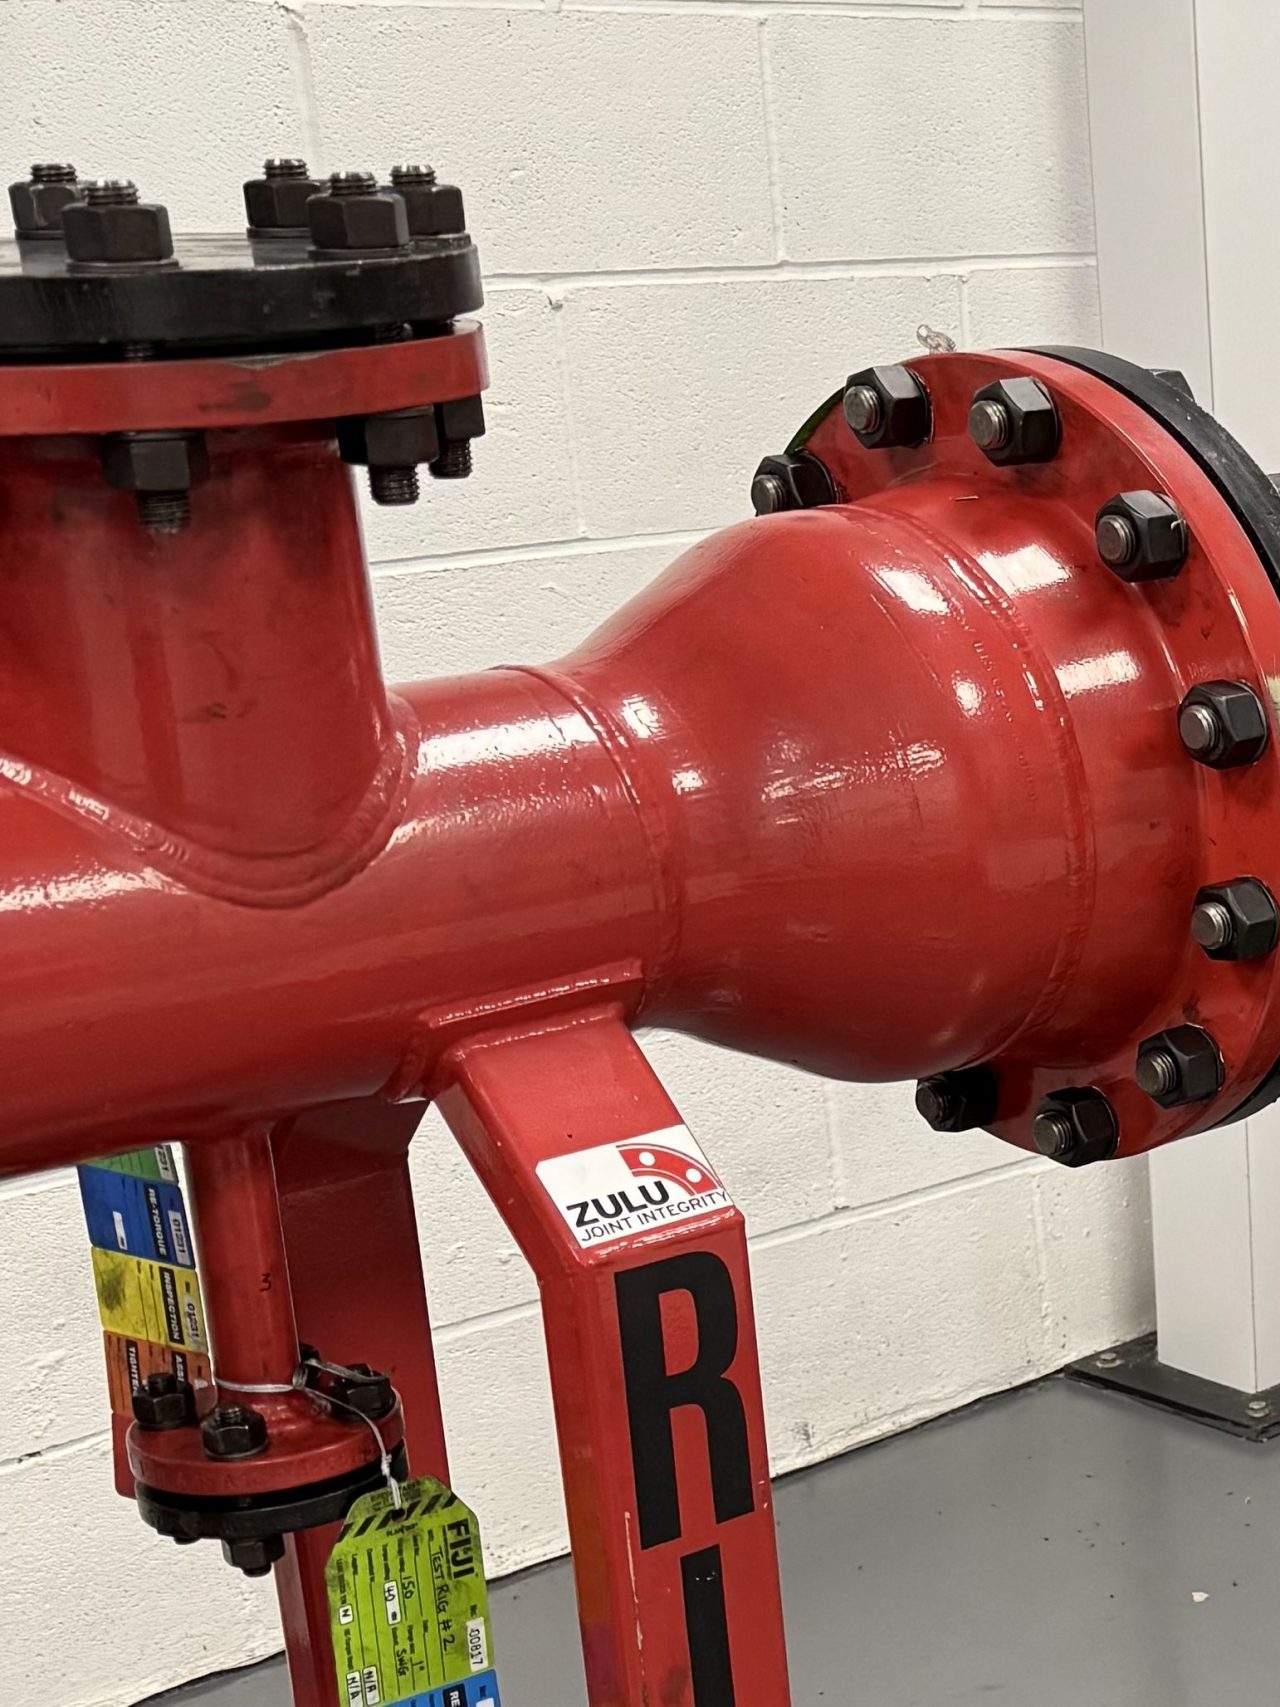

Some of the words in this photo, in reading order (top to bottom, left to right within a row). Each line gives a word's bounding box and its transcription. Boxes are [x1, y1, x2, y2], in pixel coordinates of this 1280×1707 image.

[148, 1188, 167, 1256] RE-TORQUE
[566, 1180, 670, 1228] ZULU
[581, 1217, 633, 1242] JOINT
[638, 1190, 728, 1225] INTEGRITY
[163, 1272, 180, 1340] INSPECTION
[431, 1545, 444, 1580] TEST
[447, 1518, 475, 1579] FIJI
[402, 1576, 415, 1599] 150
[436, 1584, 450, 1614] RIG
[469, 1628, 484, 1666] 00817
